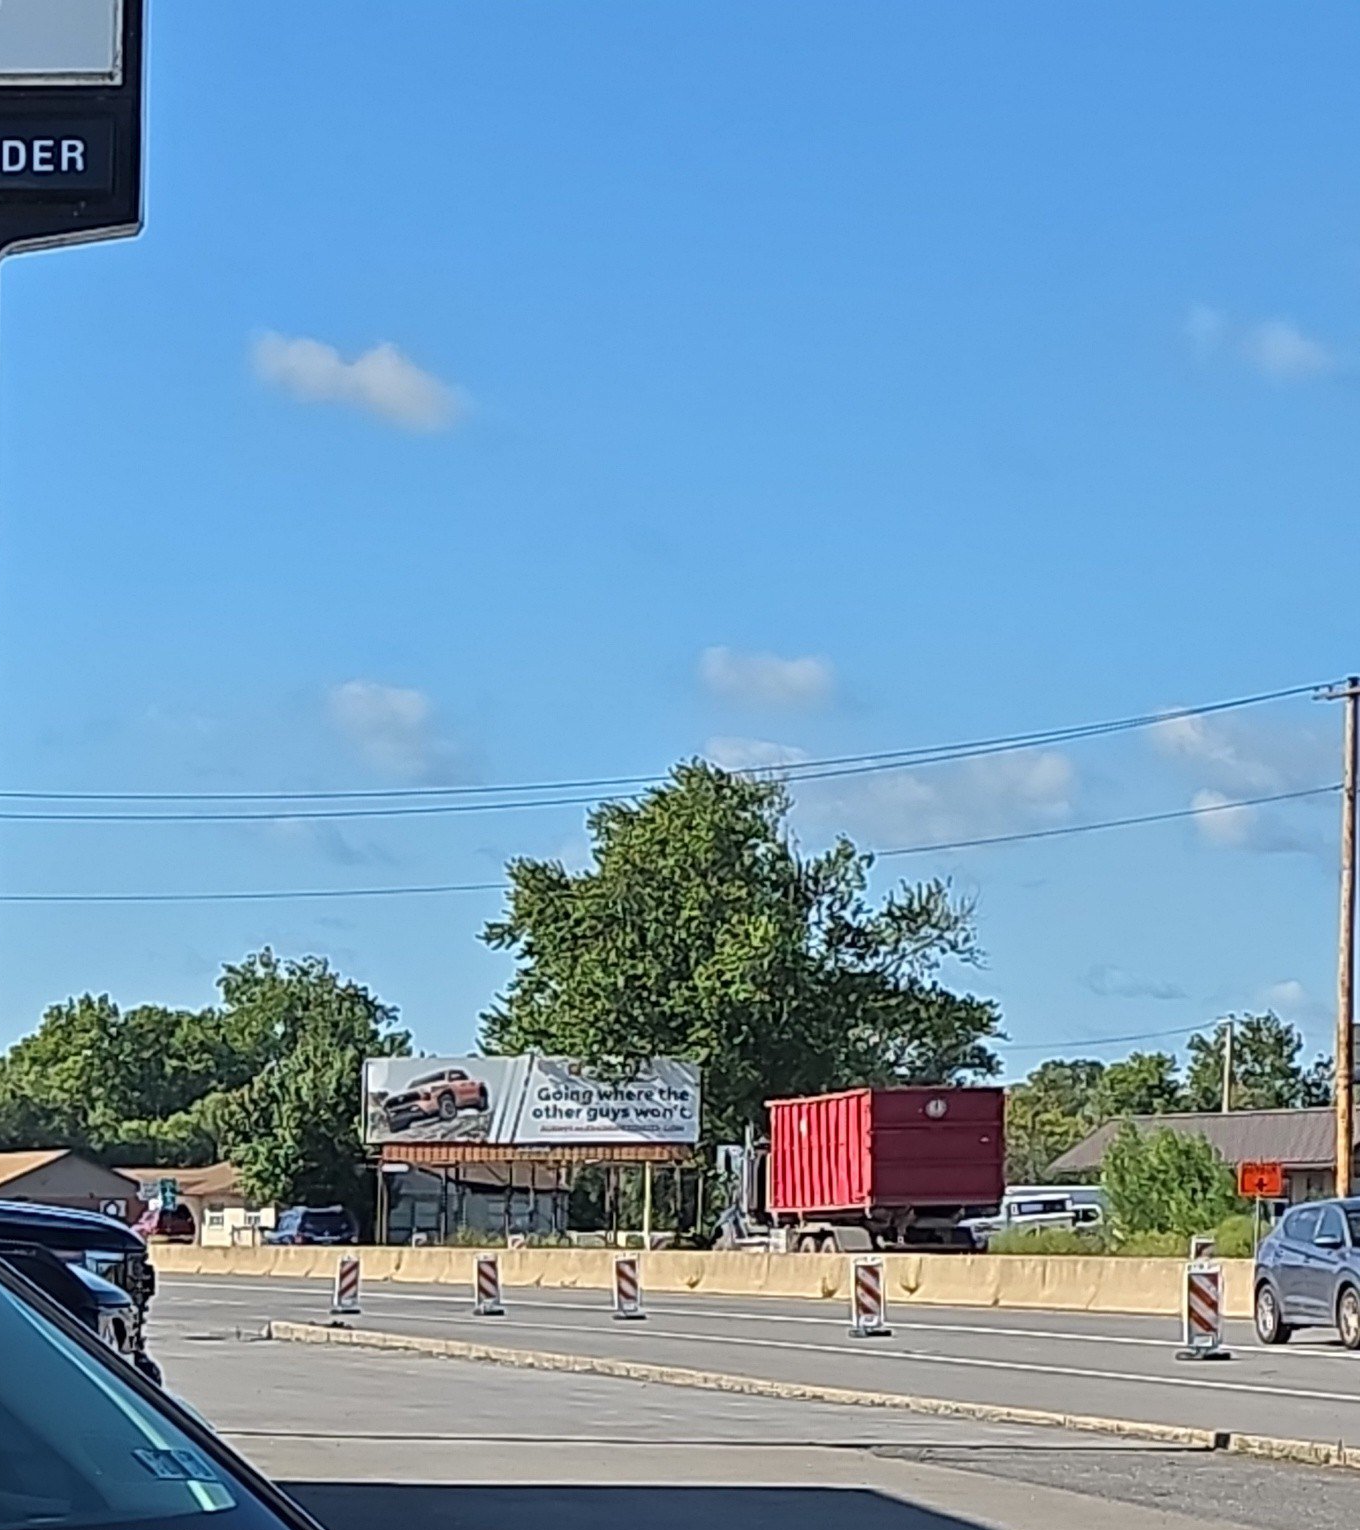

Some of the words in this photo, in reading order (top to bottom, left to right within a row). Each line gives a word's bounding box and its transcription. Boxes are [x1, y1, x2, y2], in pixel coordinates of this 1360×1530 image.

[537, 1086, 593, 1105] Going
[598, 1085, 654, 1103] where
[659, 1086, 689, 1102] the
[532, 1104, 581, 1120] other
[586, 1105, 629, 1122] guys
